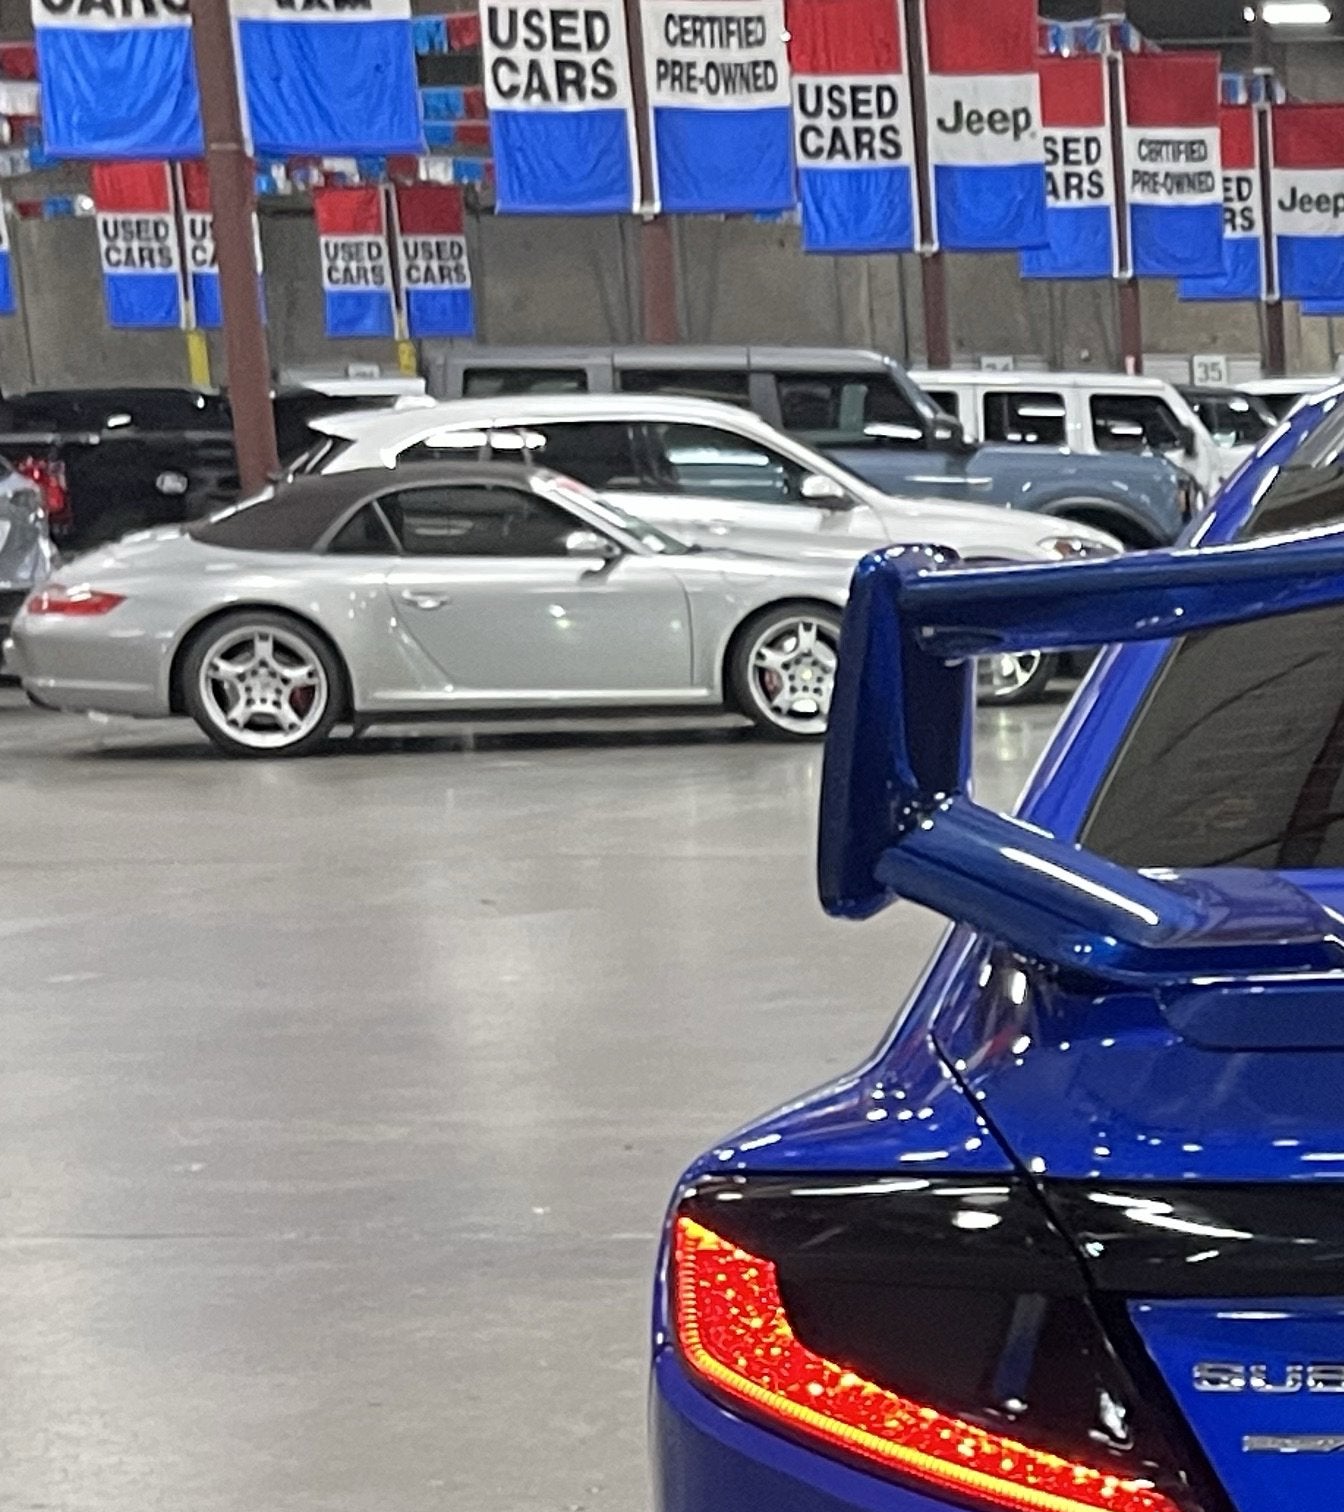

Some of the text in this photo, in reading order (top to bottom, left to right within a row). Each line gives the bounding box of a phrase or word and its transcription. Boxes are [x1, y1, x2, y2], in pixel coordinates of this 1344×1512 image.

[488, 7, 610, 52] USED
[664, 13, 766, 48] CERTIFIED
[491, 56, 617, 102] CARS
[656, 58, 779, 95] PRE-OWNED
[798, 83, 899, 120] USED
[936, 100, 1032, 141] Jeep
[799, 124, 902, 161] CARS
[1043, 136, 1102, 166] SED
[1137, 138, 1208, 163] CERTIFIED
[1045, 169, 1104, 200] ARS
[1131, 169, 1216, 195] PRE-OWNED
[103, 218, 169, 243] USED
[105, 244, 172, 268] CARS
[324, 240, 383, 264] USED
[402, 240, 464, 262] USED
[326, 264, 385, 286] CARS
[405, 264, 467, 285] CARS
[1197, 361, 1222, 382] 35
